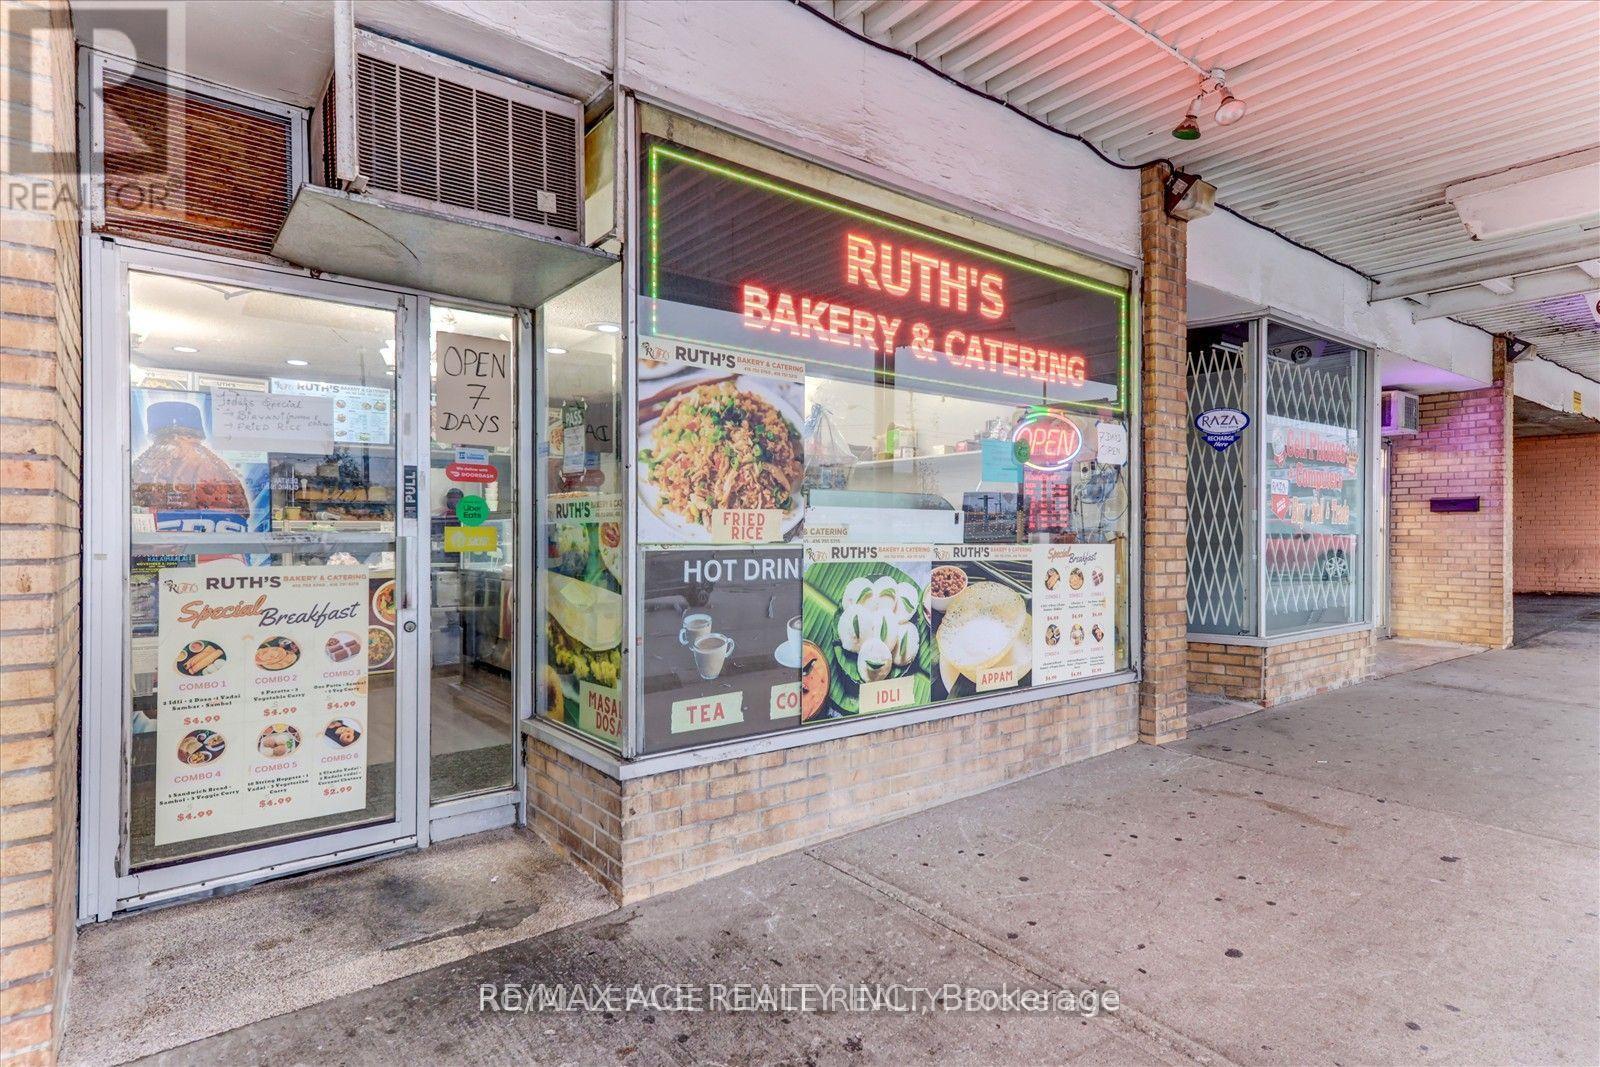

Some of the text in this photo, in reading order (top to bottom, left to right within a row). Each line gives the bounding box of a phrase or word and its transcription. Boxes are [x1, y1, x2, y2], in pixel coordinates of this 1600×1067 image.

[846, 232, 1004, 320] RUTH'S
[742, 283, 1086, 388] BAKERY & CATERING
[443, 345, 506, 379] OPEN
[675, 346, 736, 369] RUTH'S
[737, 355, 766, 368] BAKERY
[772, 361, 804, 373] CATERING
[296, 382, 340, 393] RUTH'S
[466, 383, 490, 410] 7
[440, 411, 500, 433] DAYS
[565, 410, 583, 427] PASS
[1202, 415, 1239, 428] RAZA
[1016, 426, 1076, 457] OPEN
[405, 471, 417, 503] PULL
[555, 501, 591, 519] RUTH'S
[723, 511, 766, 527] FRIED
[731, 526, 764, 540] RICE
[810, 527, 848, 536] CATERING
[831, 546, 878, 559] RUTH'S
[953, 547, 990, 558] RUTH'S
[683, 557, 799, 583] HOT DRIN
[206, 576, 282, 590] RUTH'S
[327, 573, 367, 581] CATERING
[177, 594, 268, 629] Special
[258, 601, 361, 628] Breakfast
[255, 675, 290, 685] COMBO
[323, 670, 354, 678] COMBO
[981, 670, 1013, 686] APPAM
[179, 681, 219, 691] COMBO
[876, 688, 900, 705] IDLI
[263, 706, 298, 717] $4.99
[326, 700, 356, 710] $4.99
[183, 715, 220, 726] $4.99
[686, 702, 725, 724] TEA
[596, 712, 623, 737] DOSA
[321, 753, 352, 763] COMBO
[254, 763, 290, 774] COMBO
[174, 772, 213, 784] COMBO
[173, 788, 207, 798] Sandwich
[322, 785, 352, 796] $2.99
[258, 796, 292, 808] $4.99
[176, 809, 213, 822] $4.99
